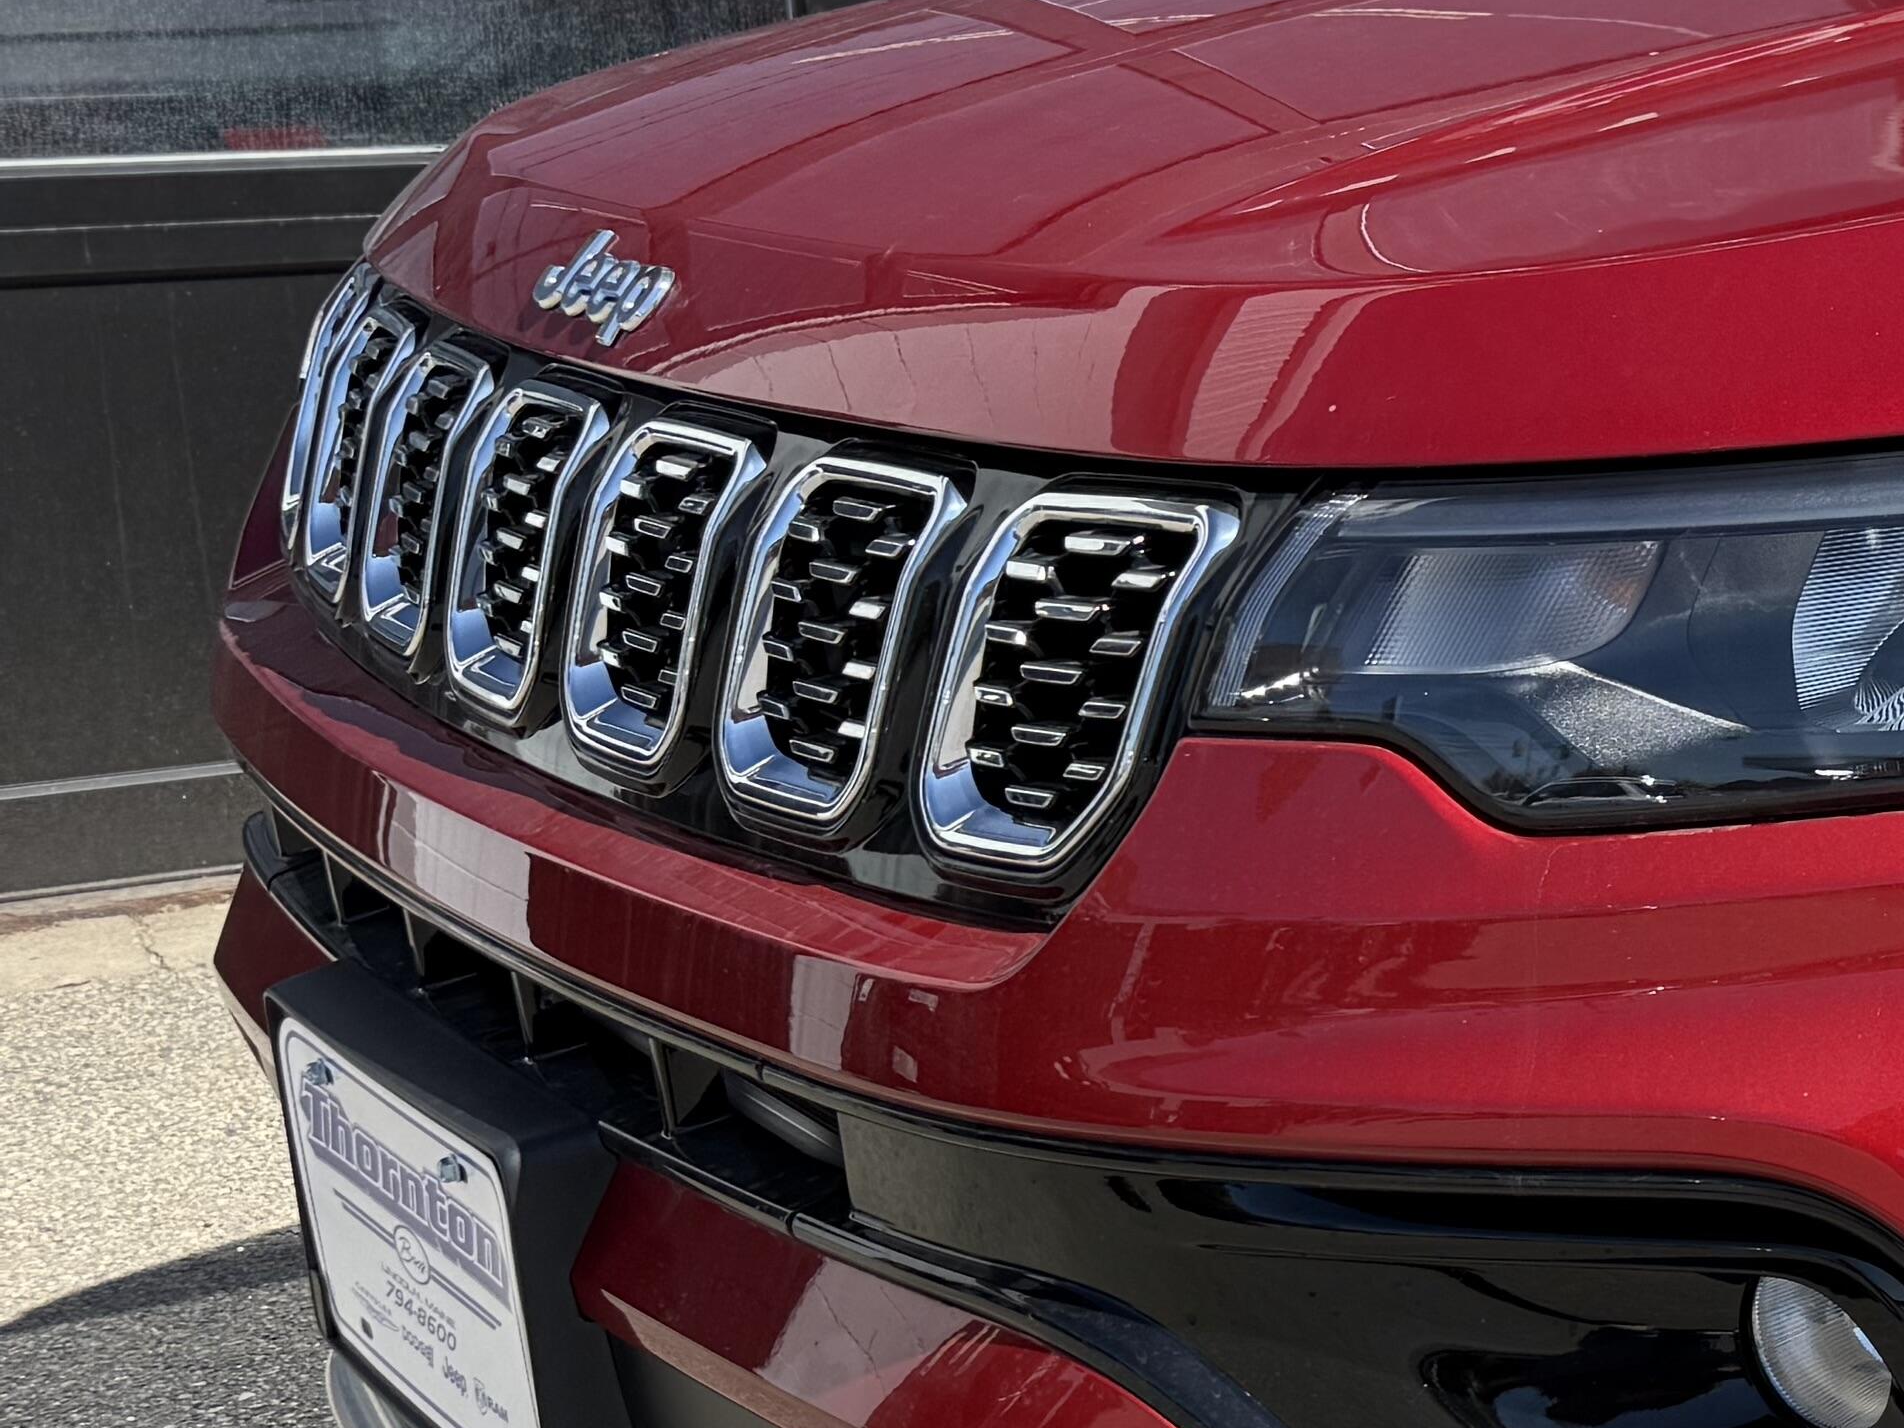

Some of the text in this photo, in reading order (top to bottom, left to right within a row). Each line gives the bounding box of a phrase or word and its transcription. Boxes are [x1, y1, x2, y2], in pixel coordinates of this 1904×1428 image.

[533, 229, 676, 347] Jeep
[301, 1080, 503, 1289] Thornton
[385, 1280, 457, 1351] 794-8600
